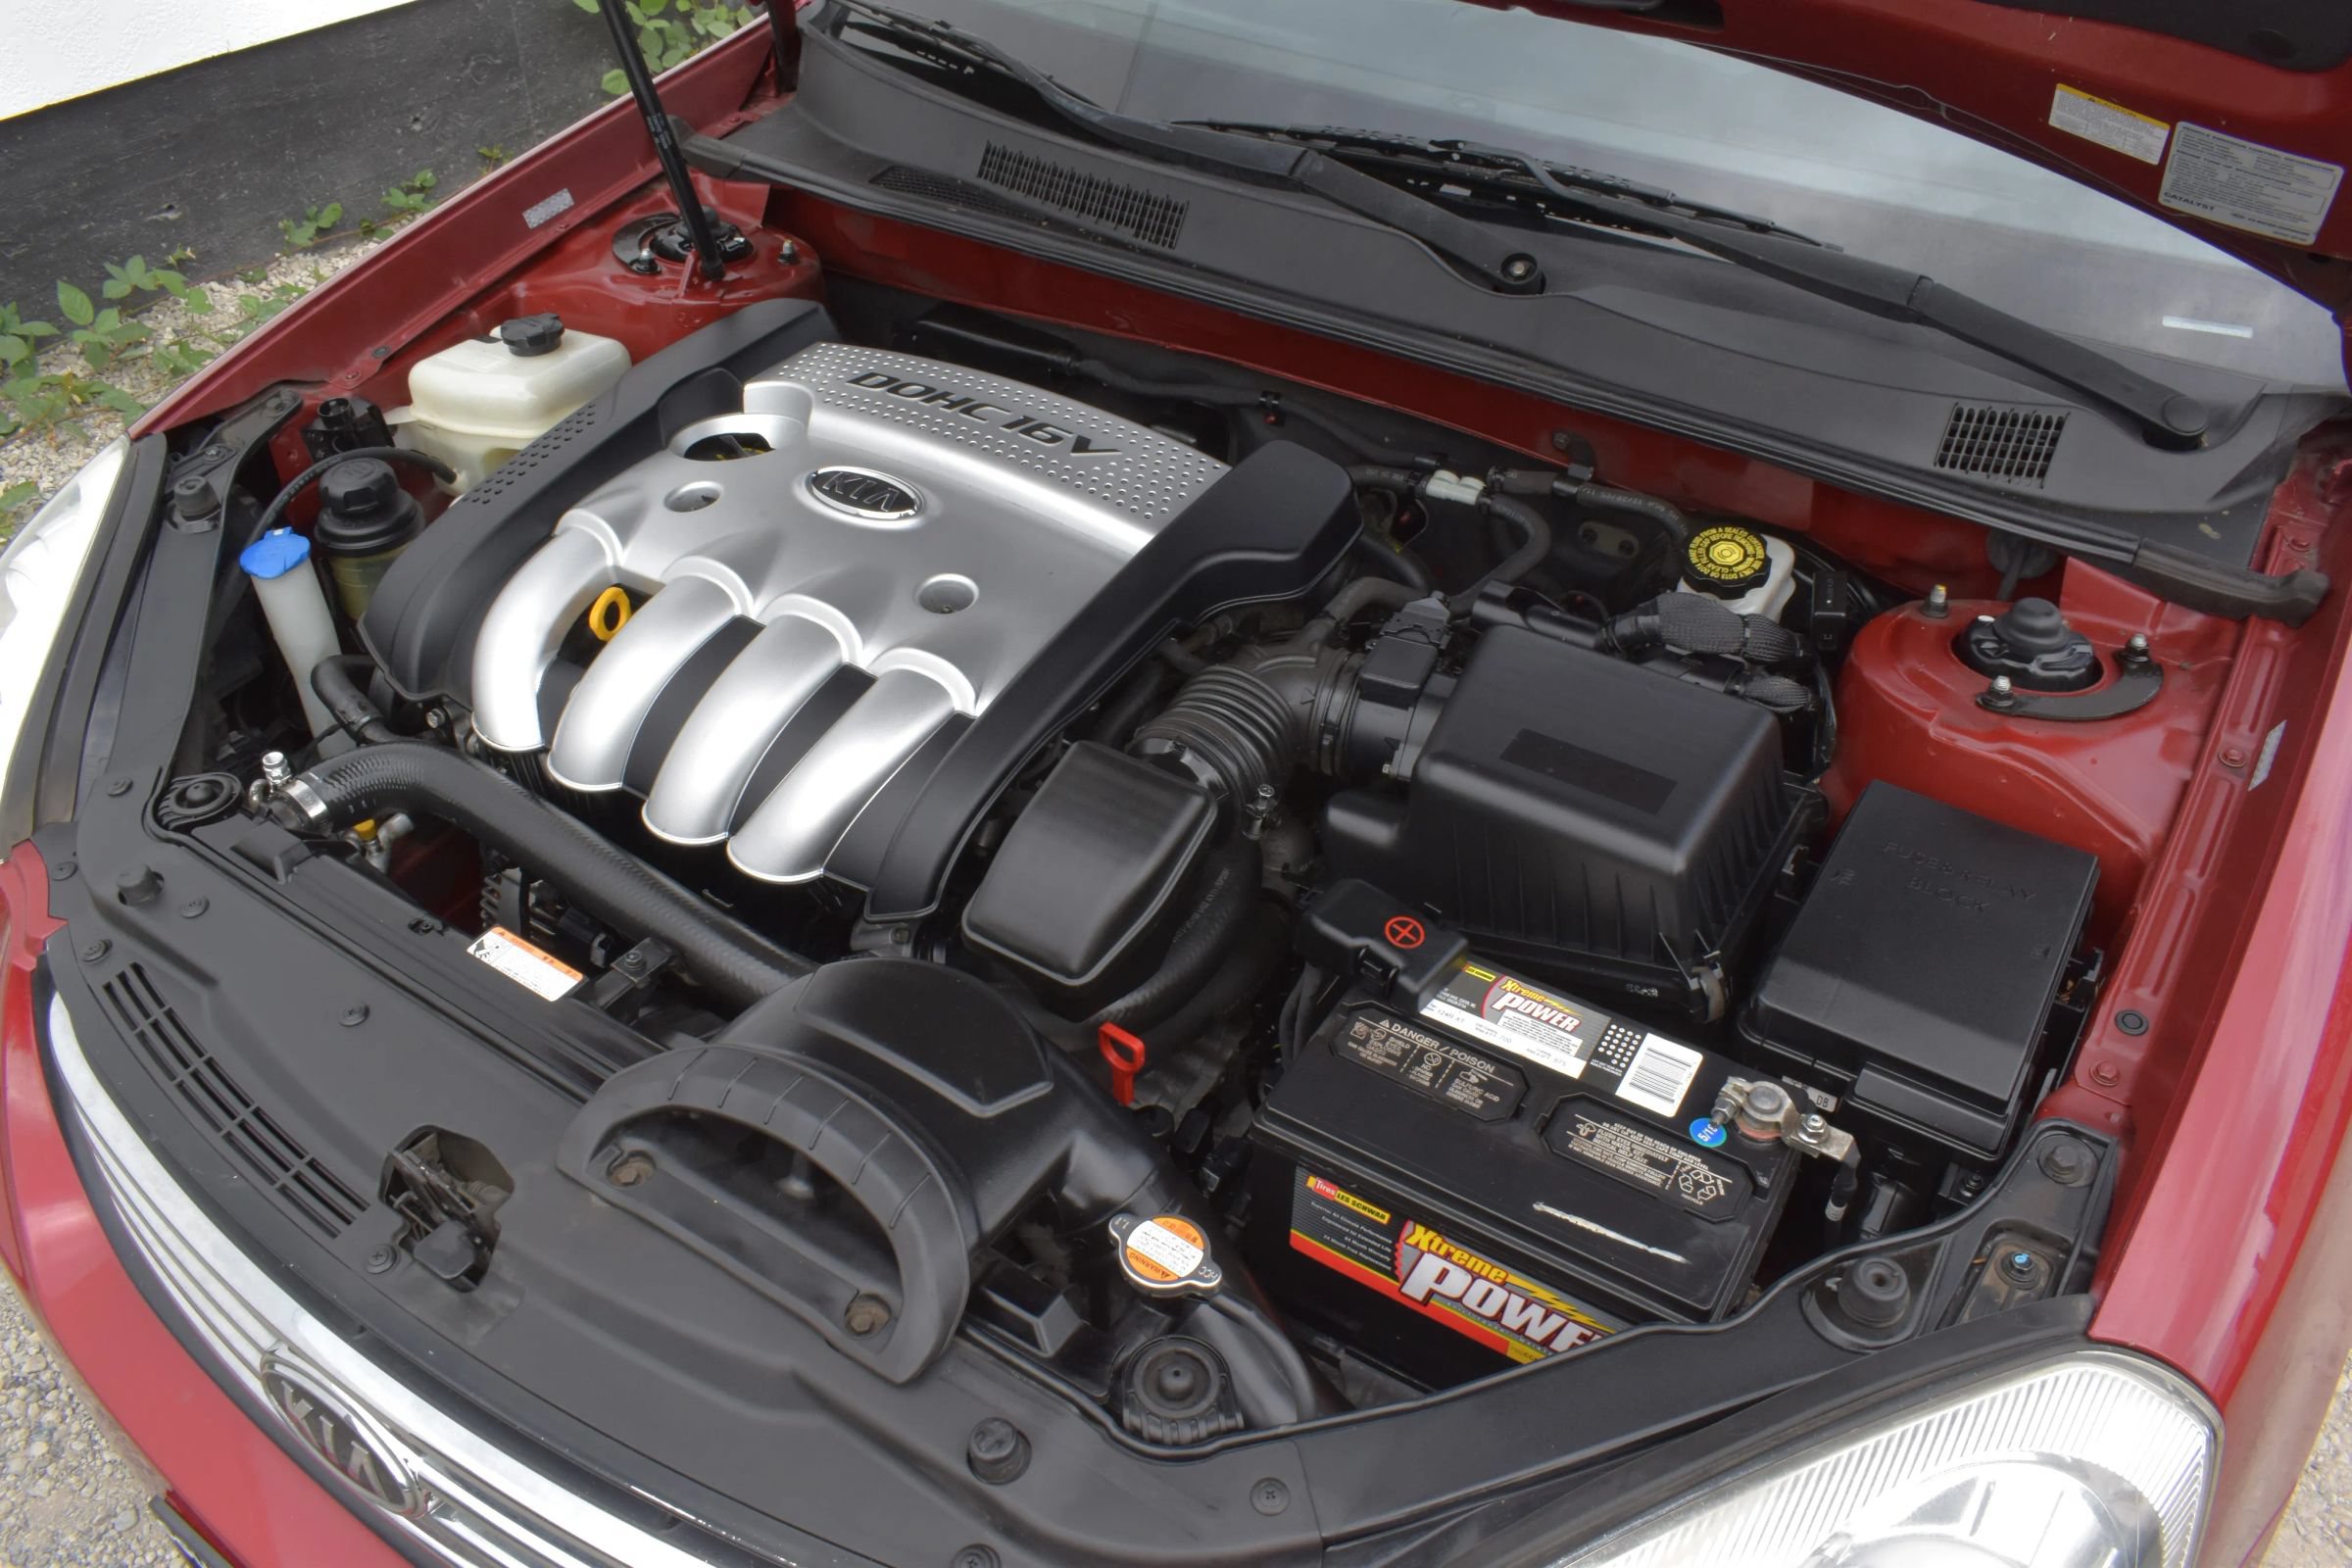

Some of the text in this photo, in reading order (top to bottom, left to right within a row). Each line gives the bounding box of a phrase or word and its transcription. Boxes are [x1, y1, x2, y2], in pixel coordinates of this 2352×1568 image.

[2163, 191, 2215, 211] CATALYST
[847, 371, 1122, 457] DOHC 16V
[822, 472, 900, 513] KIA
[1908, 877, 1990, 912] BLOCK
[1500, 979, 1545, 1003] Xtreme
[1391, 1023, 1441, 1050] DANGER
[1449, 1048, 1495, 1073] POISON
[1420, 1062, 1432, 1071] NO
[1483, 1091, 1500, 1102] ACID
[1316, 1179, 1336, 1196] Tires
[1337, 1193, 1386, 1221] LES SCHWAB
[1129, 1252, 1161, 1275] WARNING
[1405, 1222, 1509, 1285] Xtreme
[1400, 1251, 1603, 1352] POWE
[280, 1380, 390, 1502] KIA
